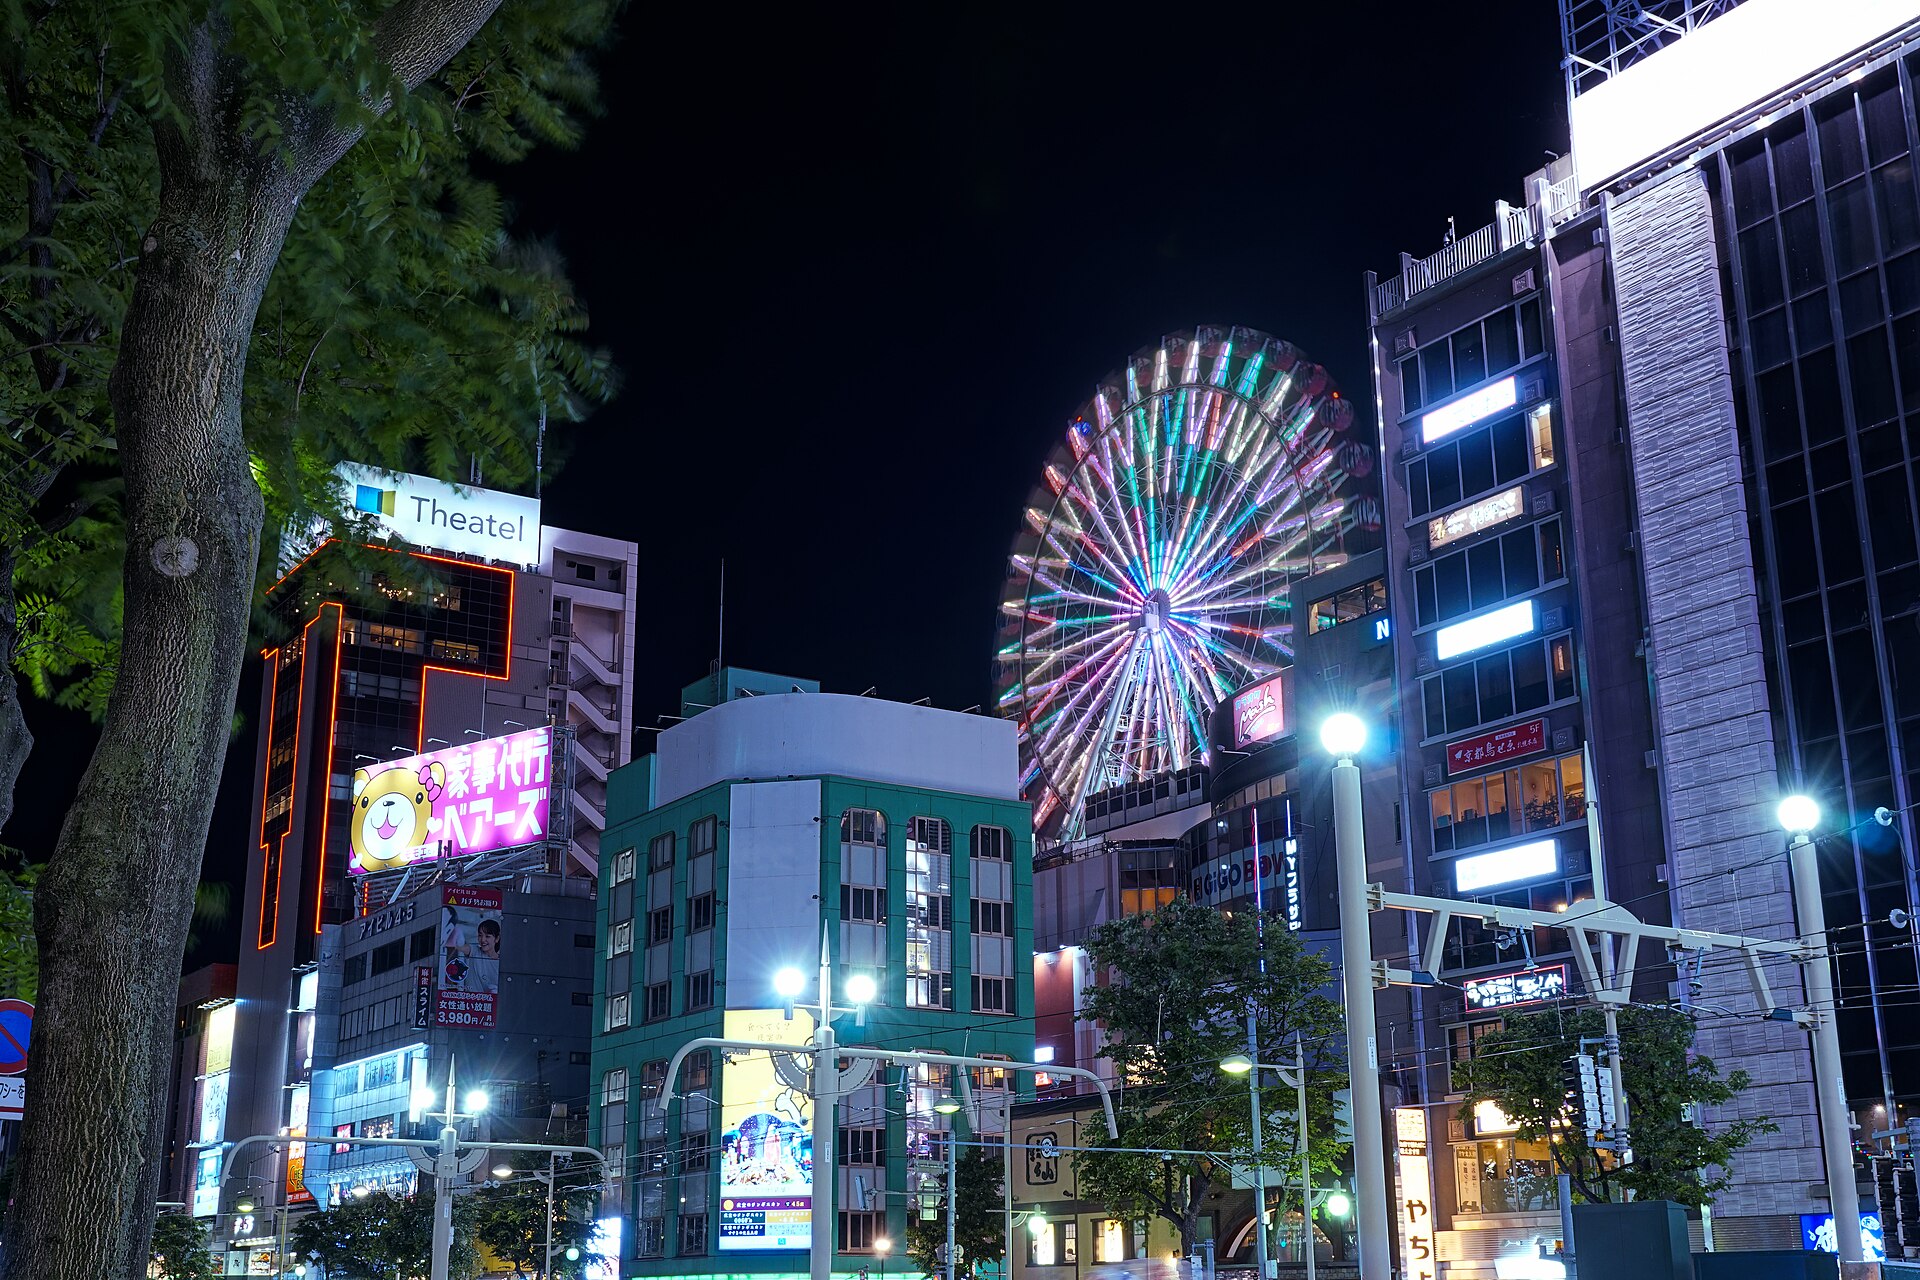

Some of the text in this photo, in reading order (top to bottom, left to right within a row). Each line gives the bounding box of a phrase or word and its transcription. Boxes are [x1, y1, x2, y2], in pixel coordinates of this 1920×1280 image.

[410, 495, 524, 541] Theatel
[1376, 618, 1390, 640] N
[1238, 684, 1276, 743] Mash
[1529, 722, 1540, 734] 5F
[447, 734, 550, 799] 家事代行
[443, 787, 548, 850] ベアーズ
[1203, 863, 1242, 896] GiGO
[439, 999, 492, 1013] 女性通い放題
